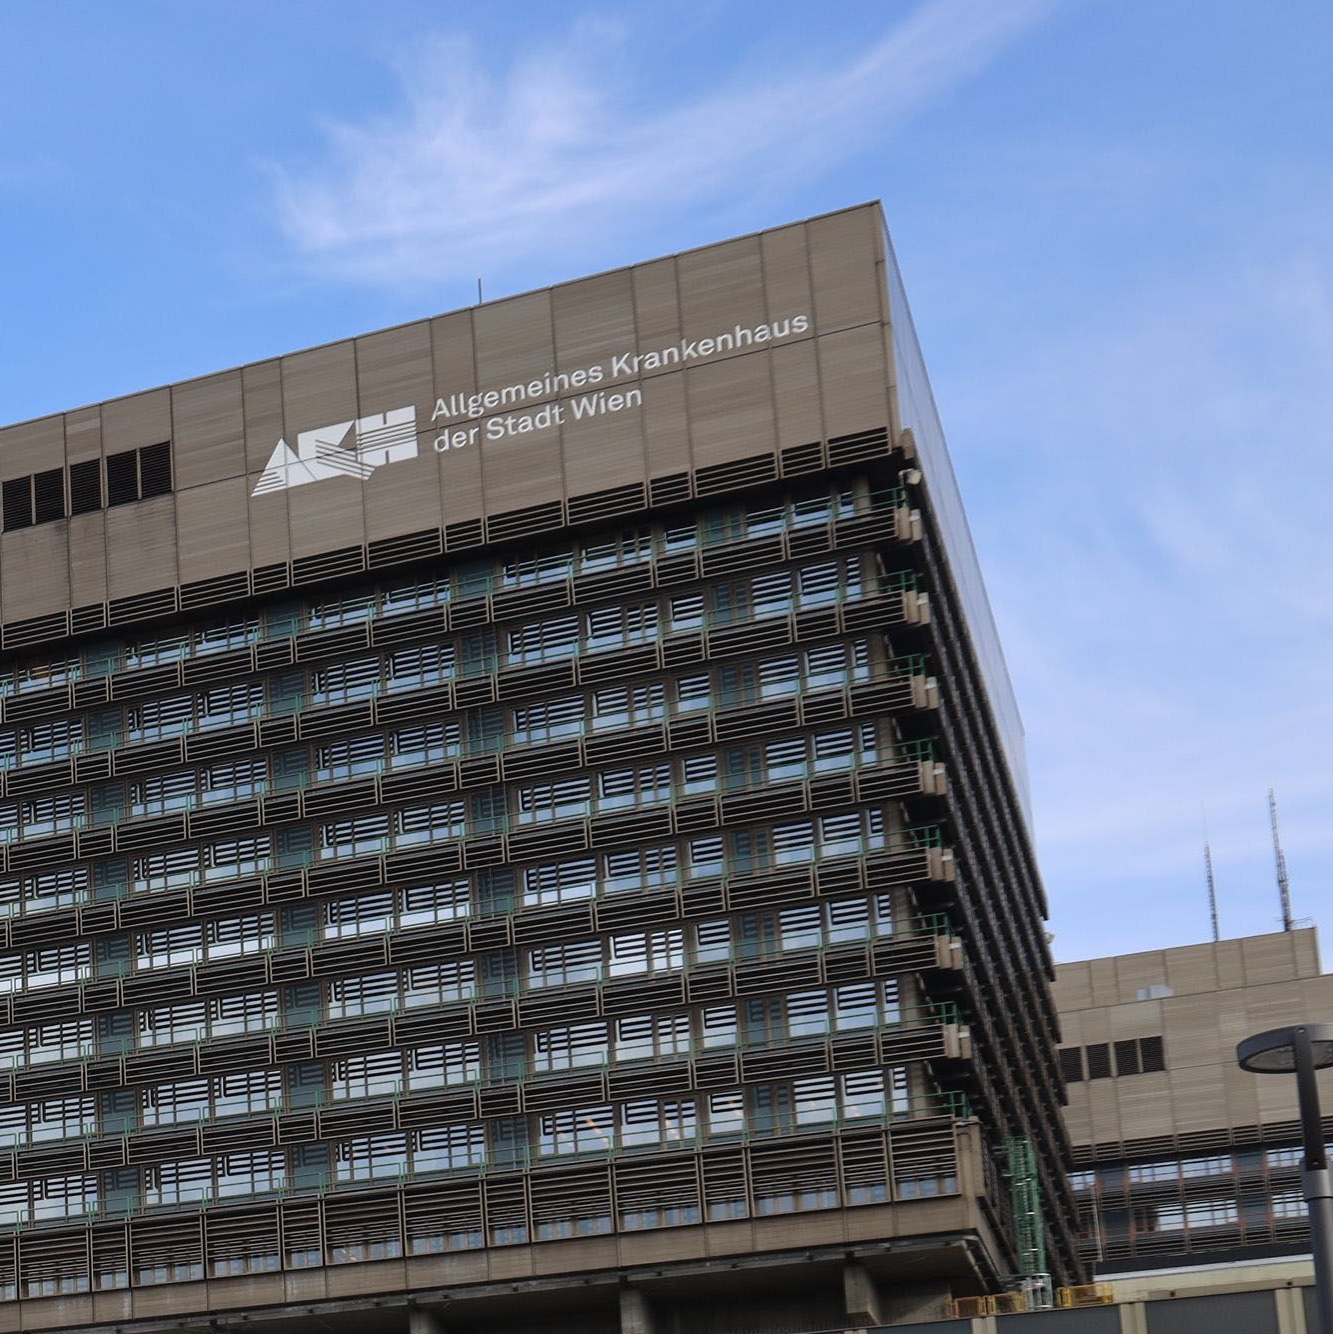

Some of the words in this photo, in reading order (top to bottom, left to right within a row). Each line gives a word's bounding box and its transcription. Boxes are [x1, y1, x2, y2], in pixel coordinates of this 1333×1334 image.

[431, 364, 604, 421] Allgemeines
[611, 313, 810, 378] Krankenhaus
[433, 425, 480, 454] der
[486, 404, 566, 442] Stadt
[572, 387, 644, 422] Wien
